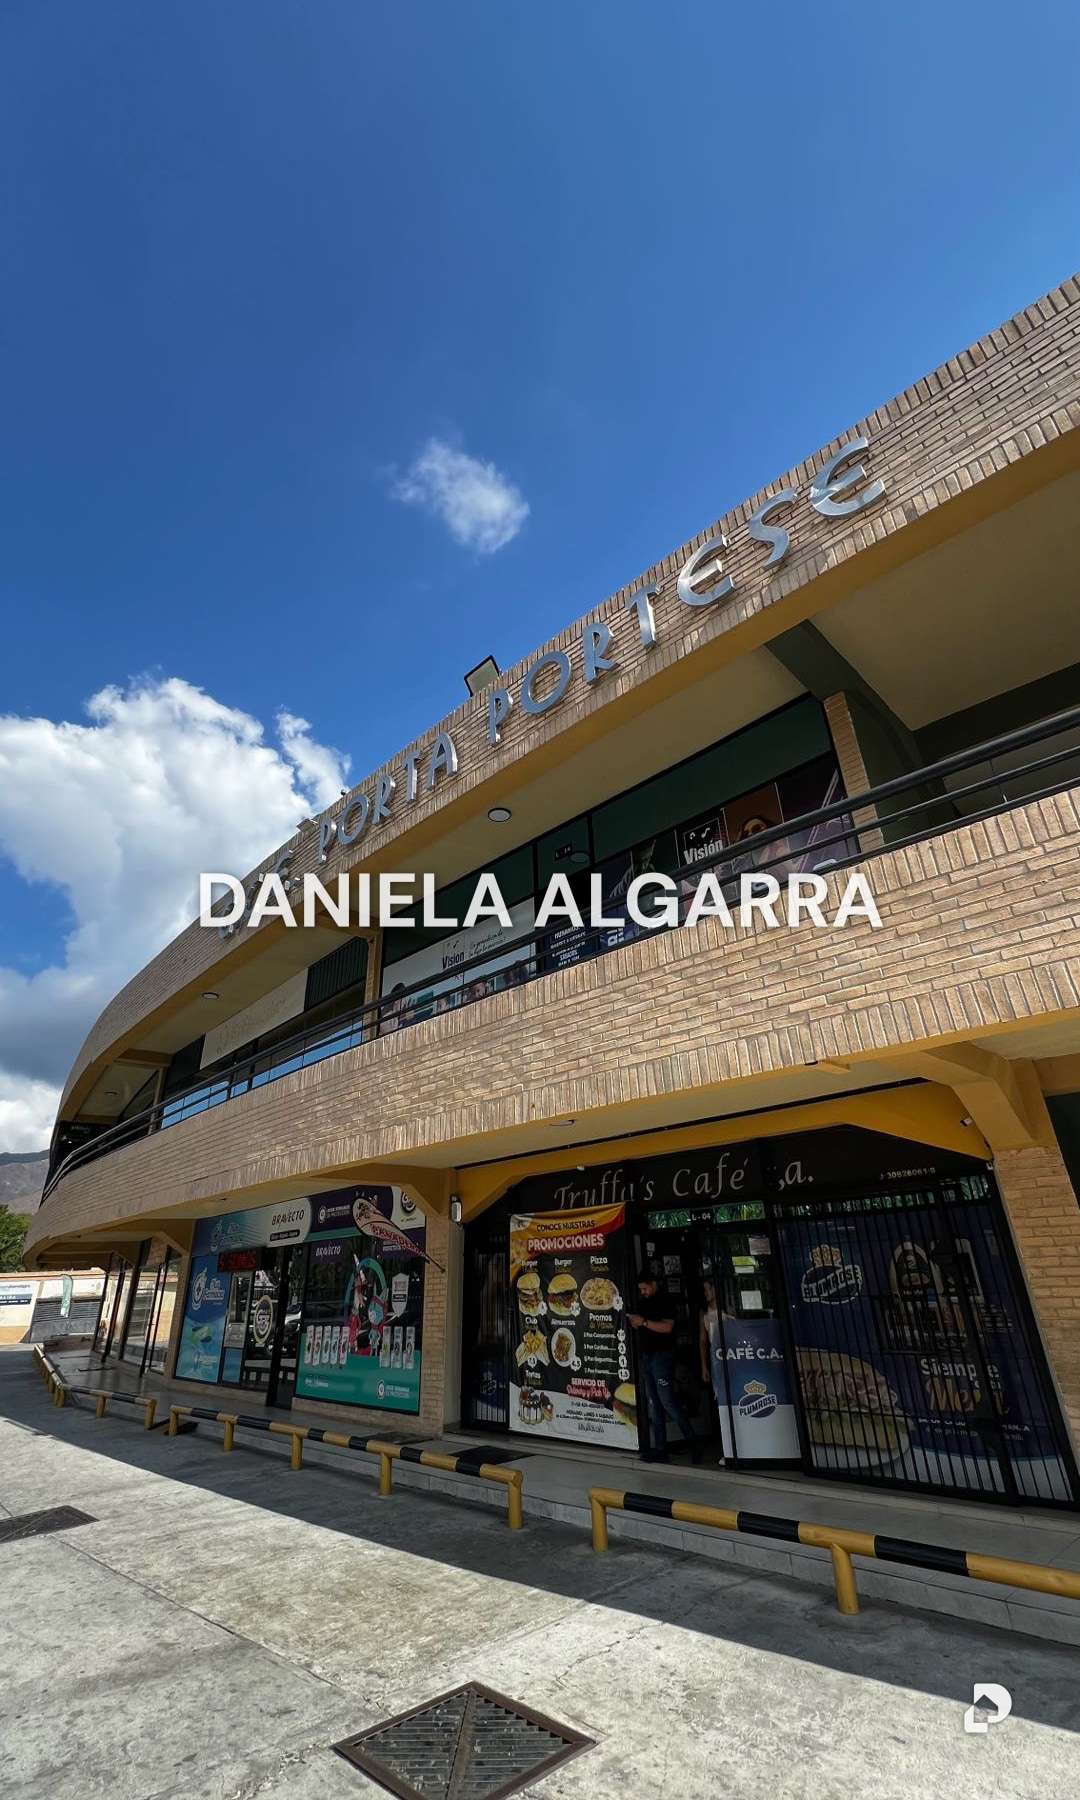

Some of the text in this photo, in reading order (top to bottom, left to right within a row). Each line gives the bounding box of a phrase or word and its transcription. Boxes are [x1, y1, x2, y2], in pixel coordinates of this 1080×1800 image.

[318, 435, 885, 863] PORTA PORTESE
[683, 839, 724, 865] Visión
[672, 1152, 750, 1199] Café
[527, 1232, 605, 1251] PROMOCIONES
[715, 1343, 784, 1361] CAFÉ C.A.
[738, 1395, 778, 1417] PLUMROSE
